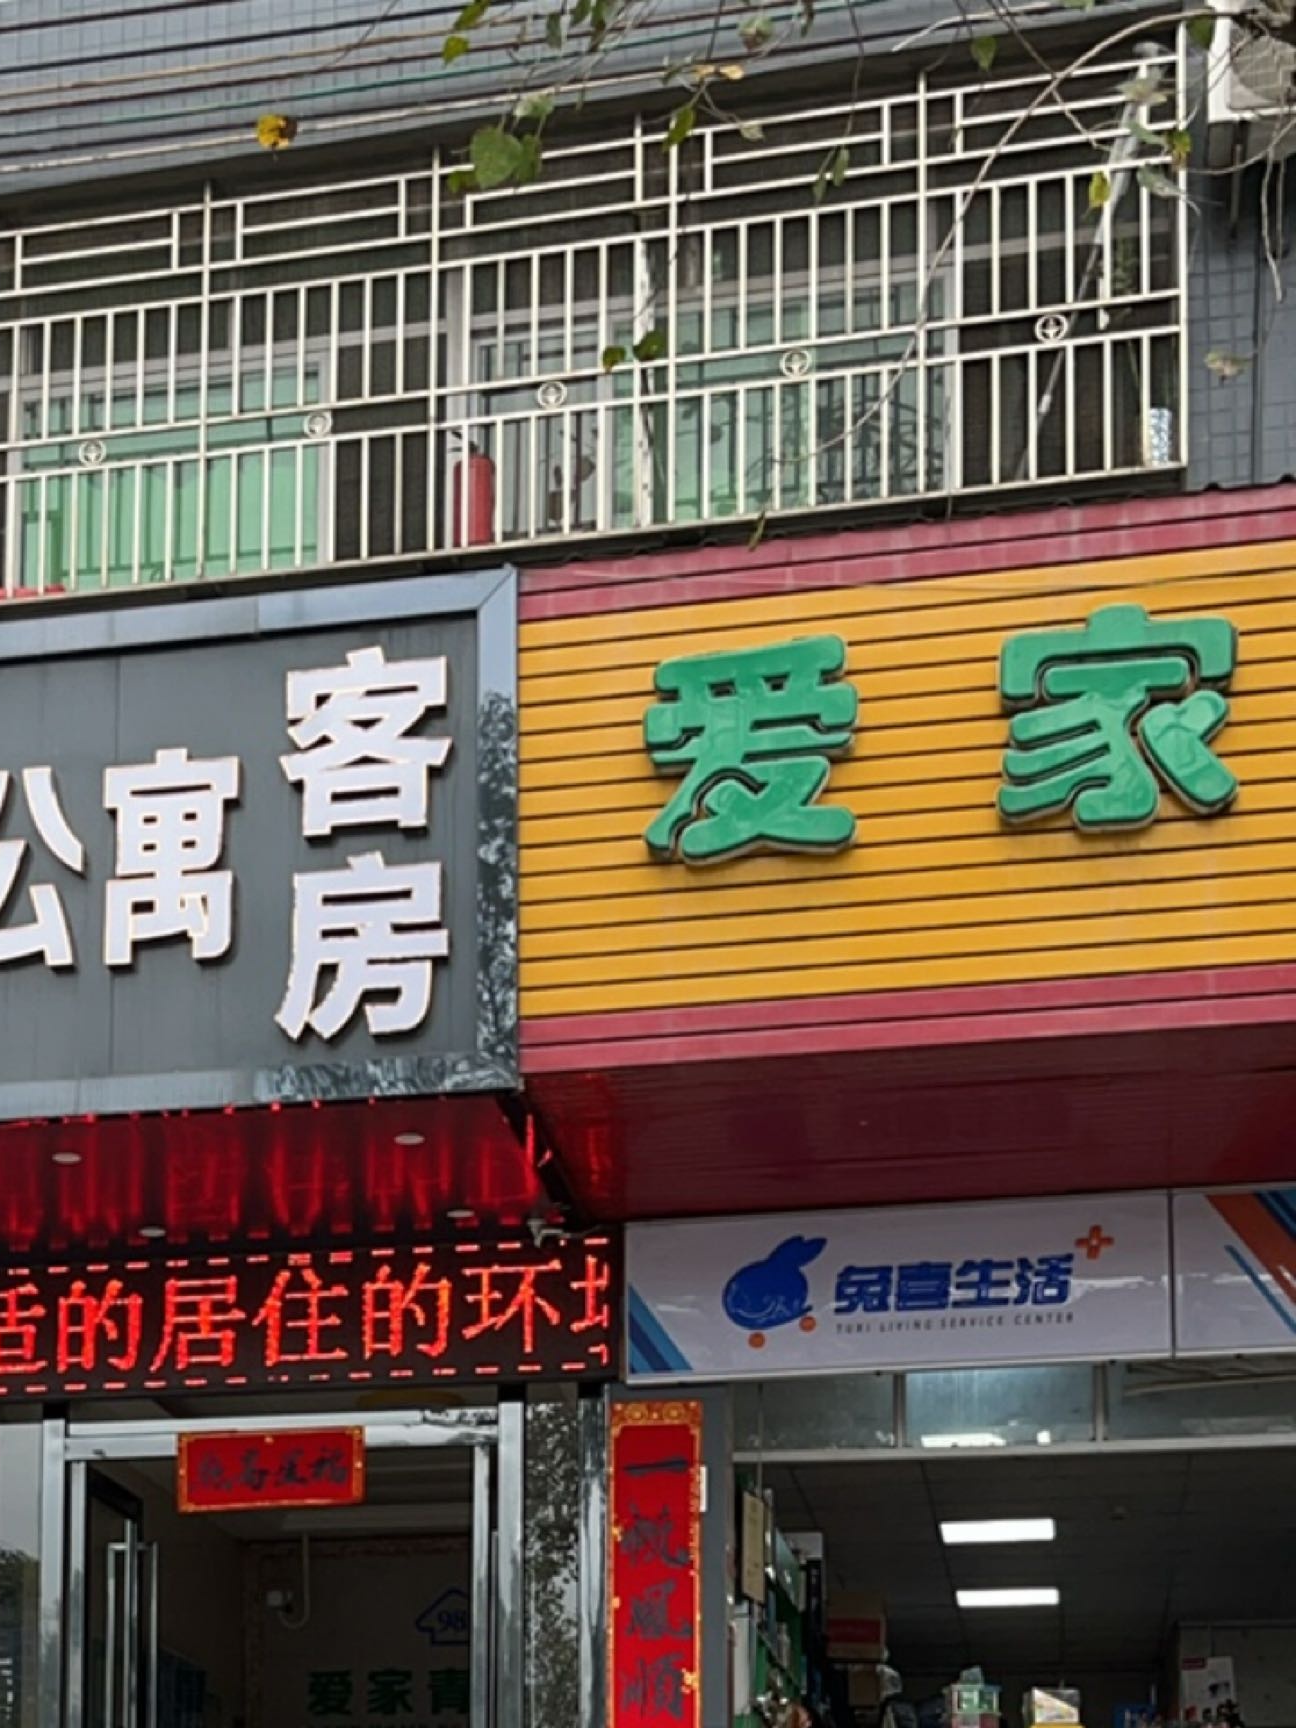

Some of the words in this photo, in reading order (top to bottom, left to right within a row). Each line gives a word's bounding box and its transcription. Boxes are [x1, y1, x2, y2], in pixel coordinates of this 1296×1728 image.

[642, 603, 1240, 866] 爱家
[273, 645, 453, 1043] 客房
[834, 1252, 1075, 1315] 兔喜生活
[940, 1314, 1005, 1330] SERVICE
[1014, 1311, 1075, 1326] CENTER
